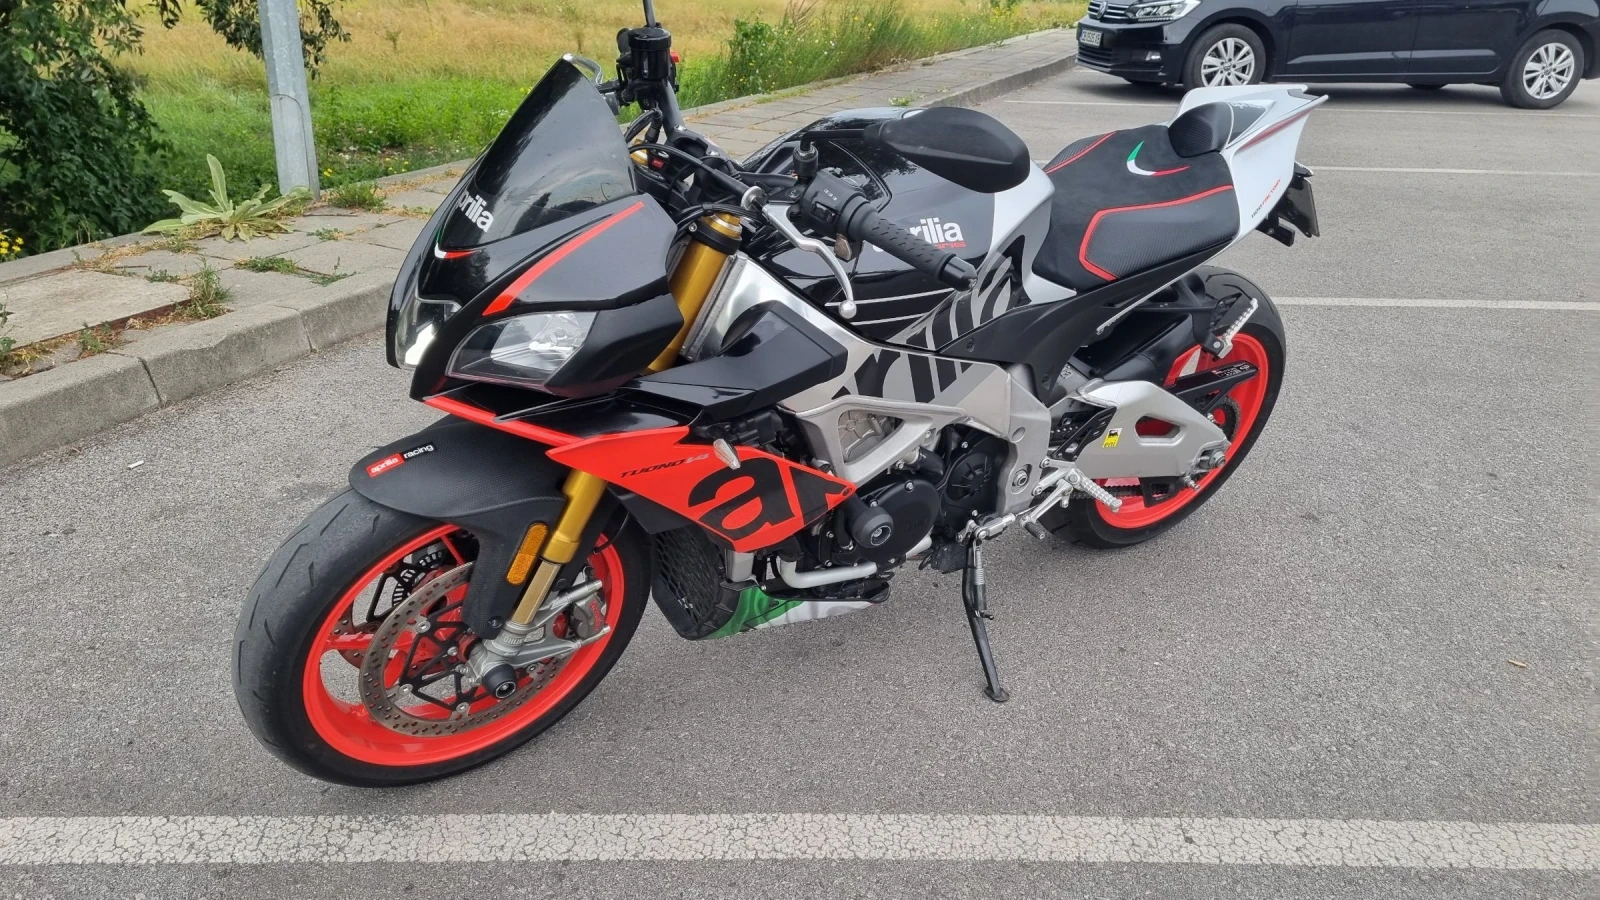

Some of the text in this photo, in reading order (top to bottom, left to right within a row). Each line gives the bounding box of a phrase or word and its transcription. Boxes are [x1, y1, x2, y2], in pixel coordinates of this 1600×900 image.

[370, 444, 434, 474] aprilia racing
[620, 459, 687, 478] TUONO
